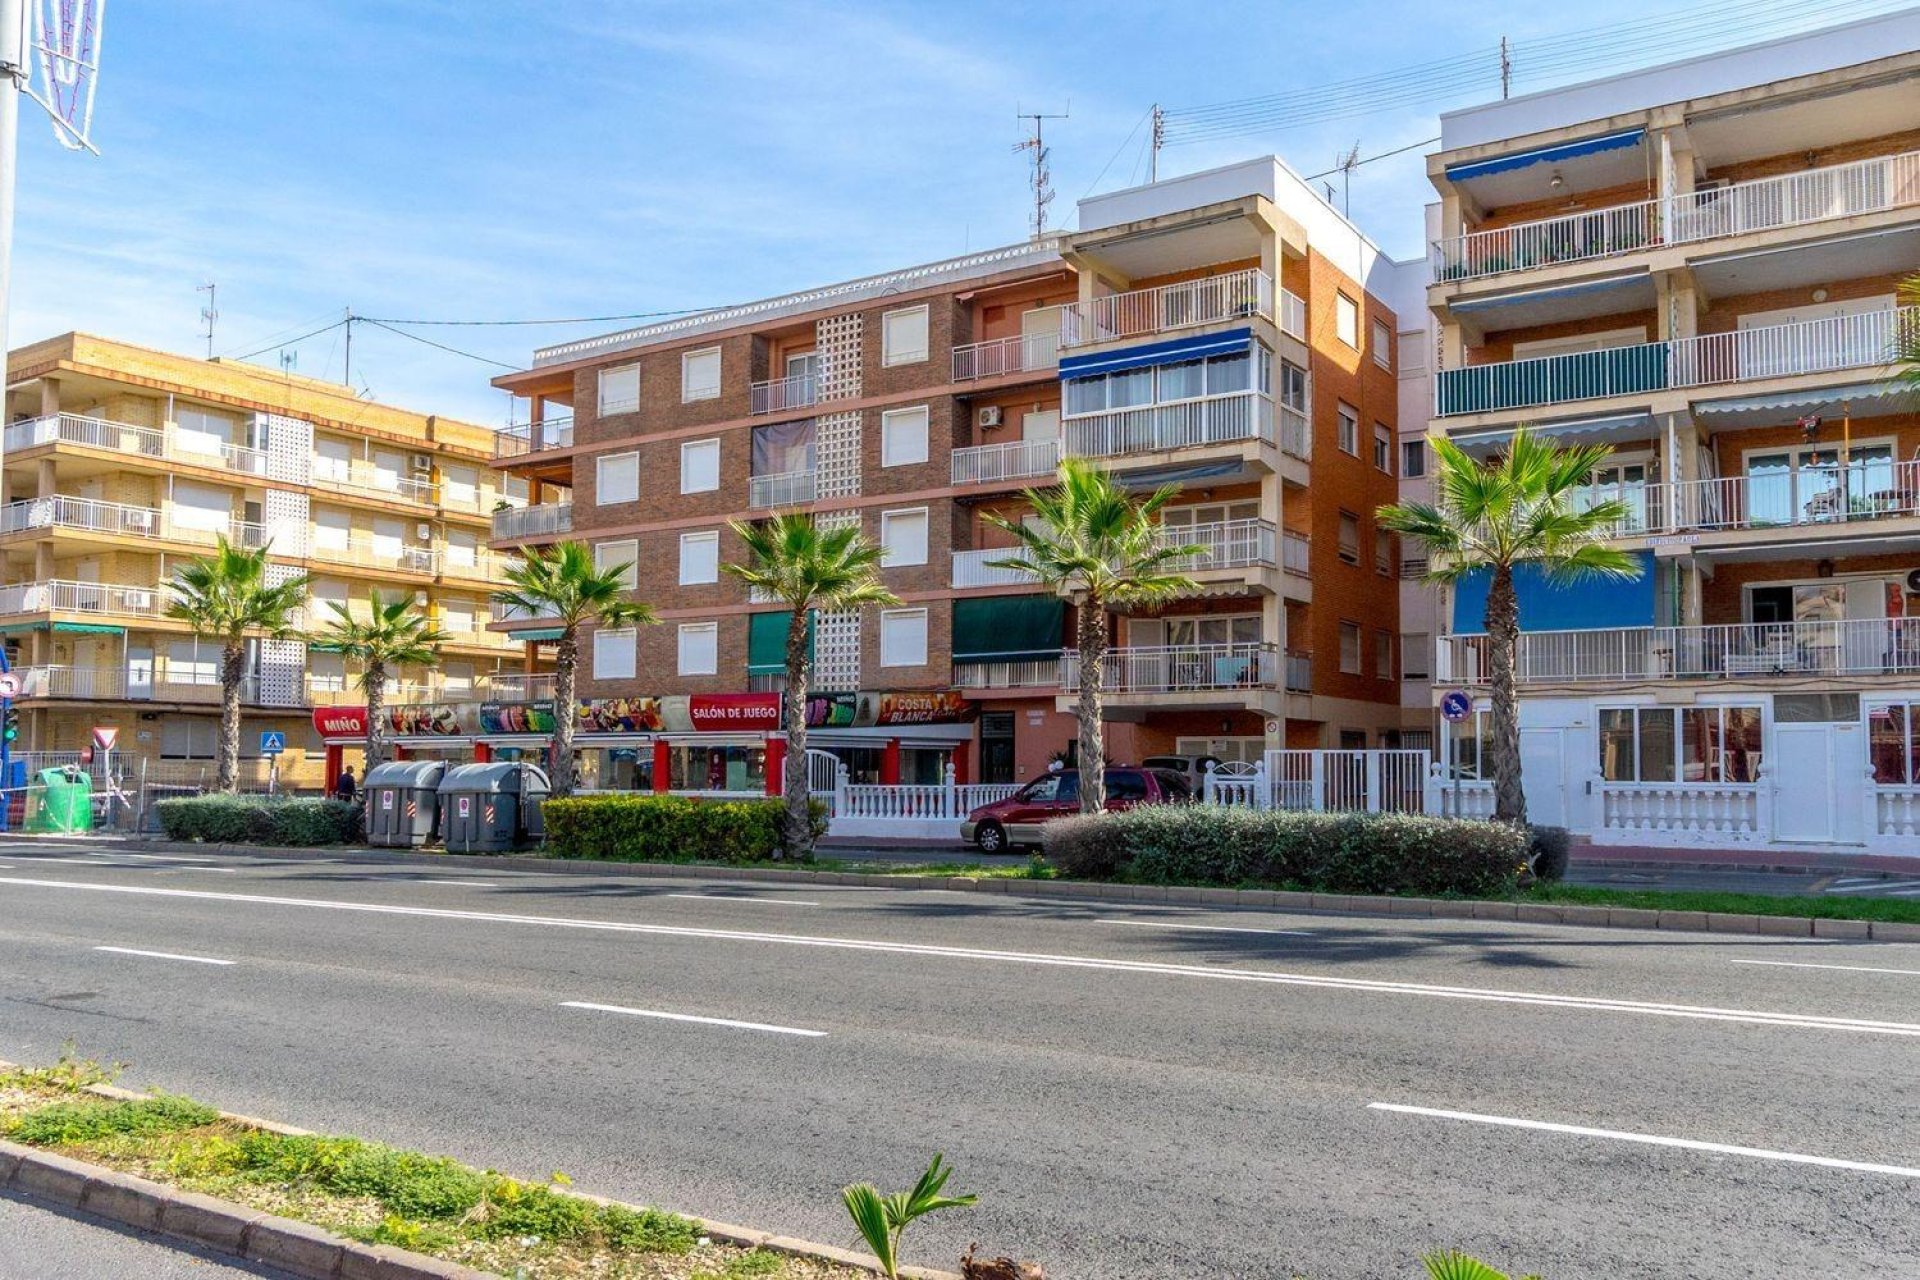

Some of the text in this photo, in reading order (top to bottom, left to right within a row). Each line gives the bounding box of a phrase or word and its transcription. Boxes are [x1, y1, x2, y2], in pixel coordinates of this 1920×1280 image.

[898, 698, 933, 710] COSTA
[693, 704, 777, 719] SALÓN DE JUEGO
[890, 710, 933, 723] BLANCA
[324, 716, 361, 732] MIÑO
